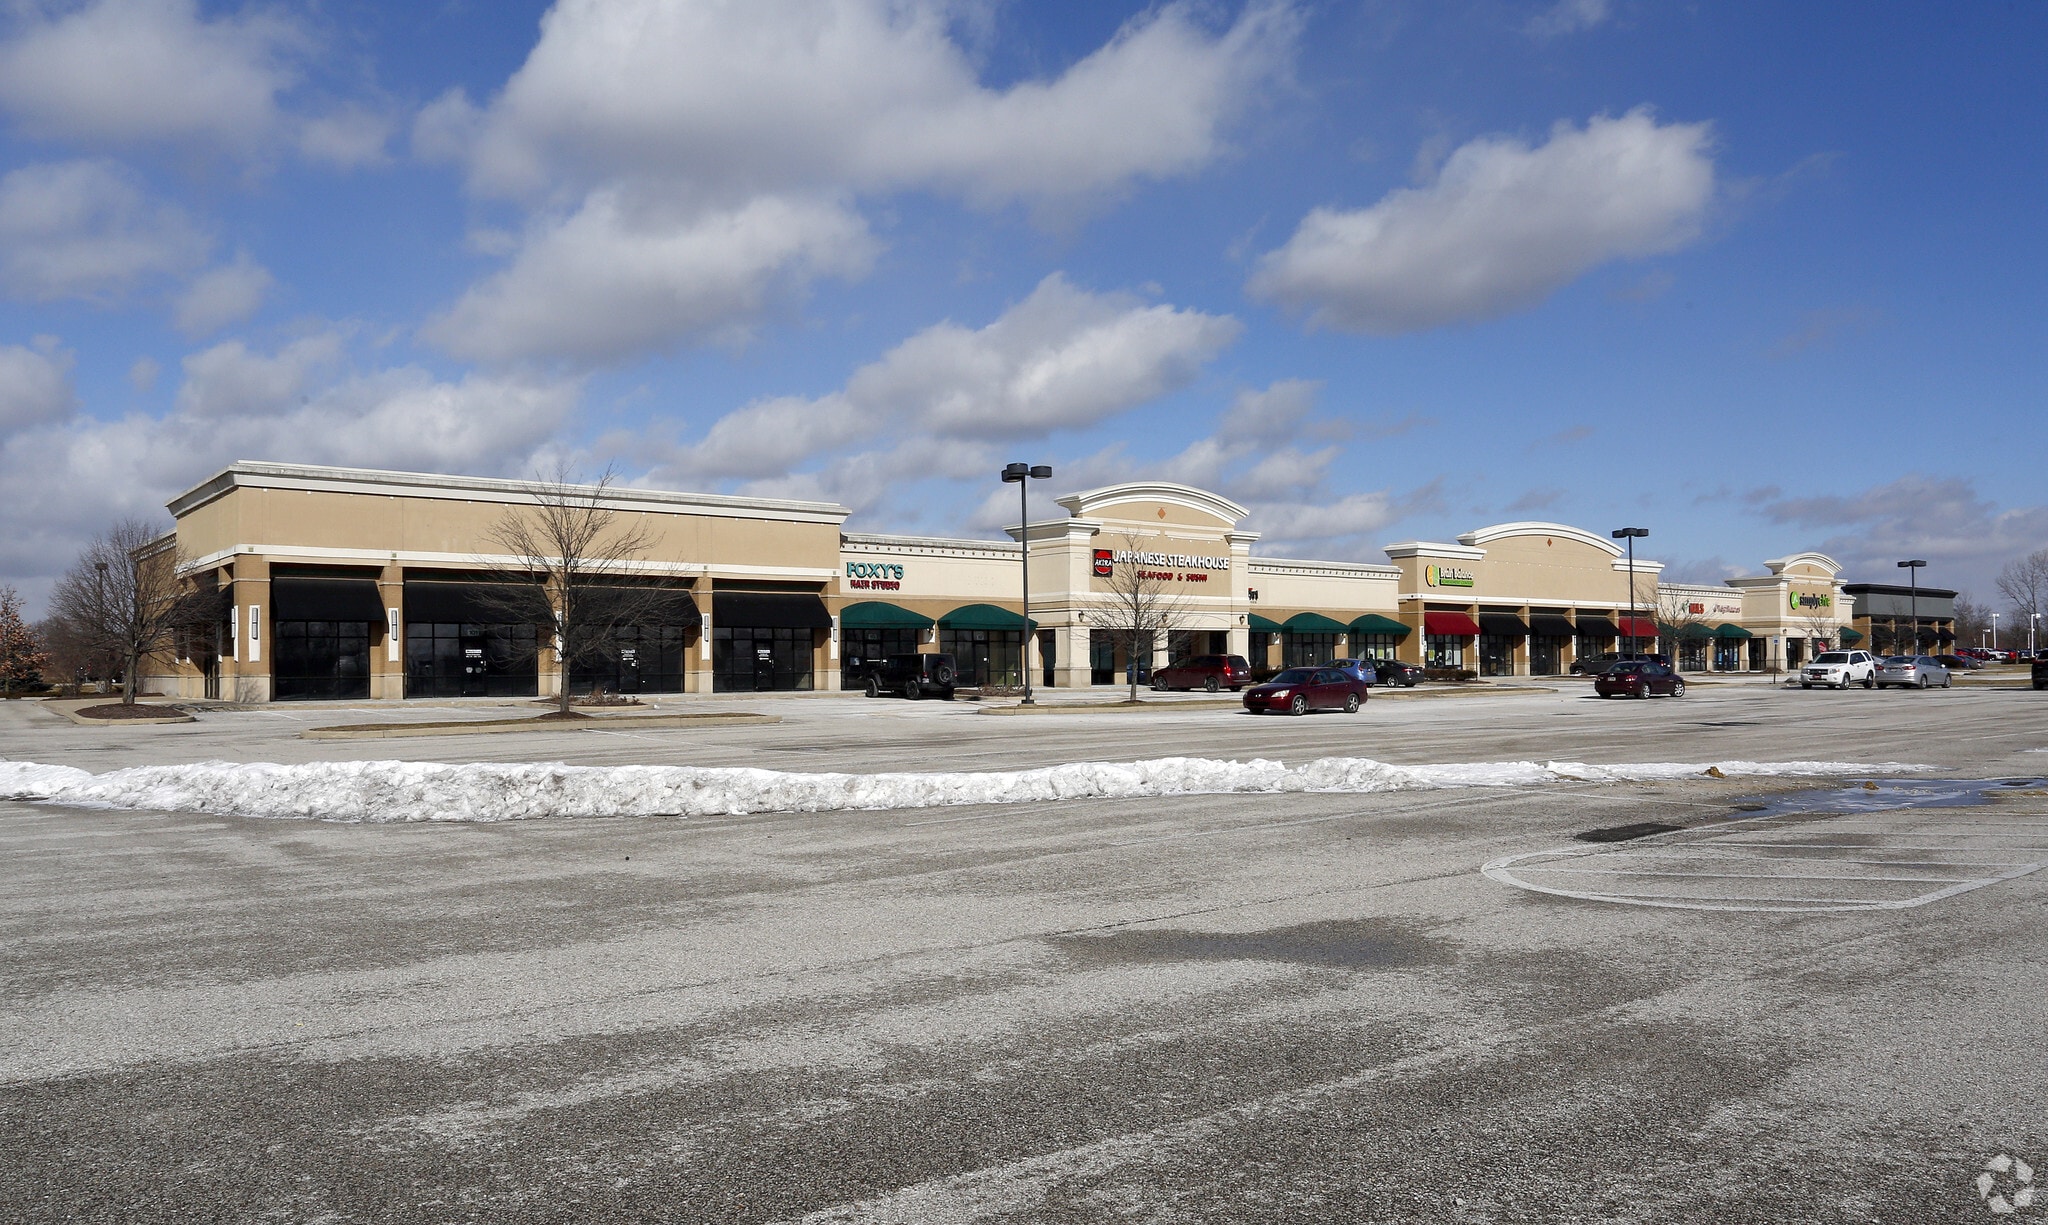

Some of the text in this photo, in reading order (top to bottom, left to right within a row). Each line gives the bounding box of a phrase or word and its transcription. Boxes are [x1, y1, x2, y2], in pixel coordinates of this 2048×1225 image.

[1094, 558, 1112, 567] AKIRA
[1113, 550, 1229, 571] JAPANESE STEAKHOUSE
[846, 562, 904, 580] FOXY'S
[1137, 570, 1208, 583] SEAFOOD & SUSHI
[850, 579, 900, 591] HAIR STUDIO
